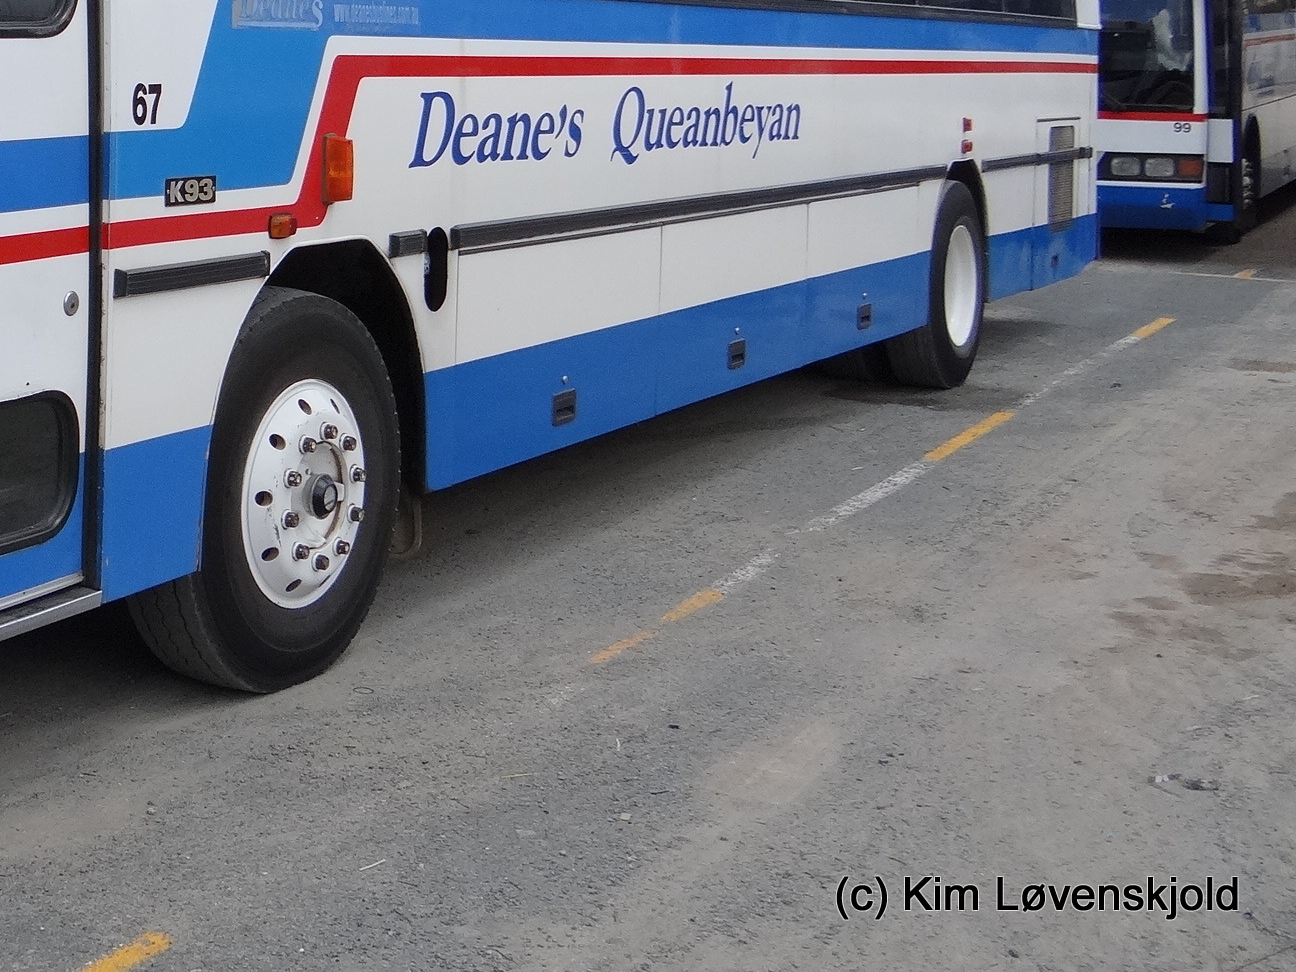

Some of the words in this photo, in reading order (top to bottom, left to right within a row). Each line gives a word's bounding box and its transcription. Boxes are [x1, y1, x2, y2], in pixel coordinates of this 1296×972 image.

[132, 82, 162, 126] 67
[408, 90, 585, 168] Deane's
[609, 81, 802, 166] Queanbeyan
[1173, 122, 1192, 134] 99
[169, 178, 214, 204] K93
